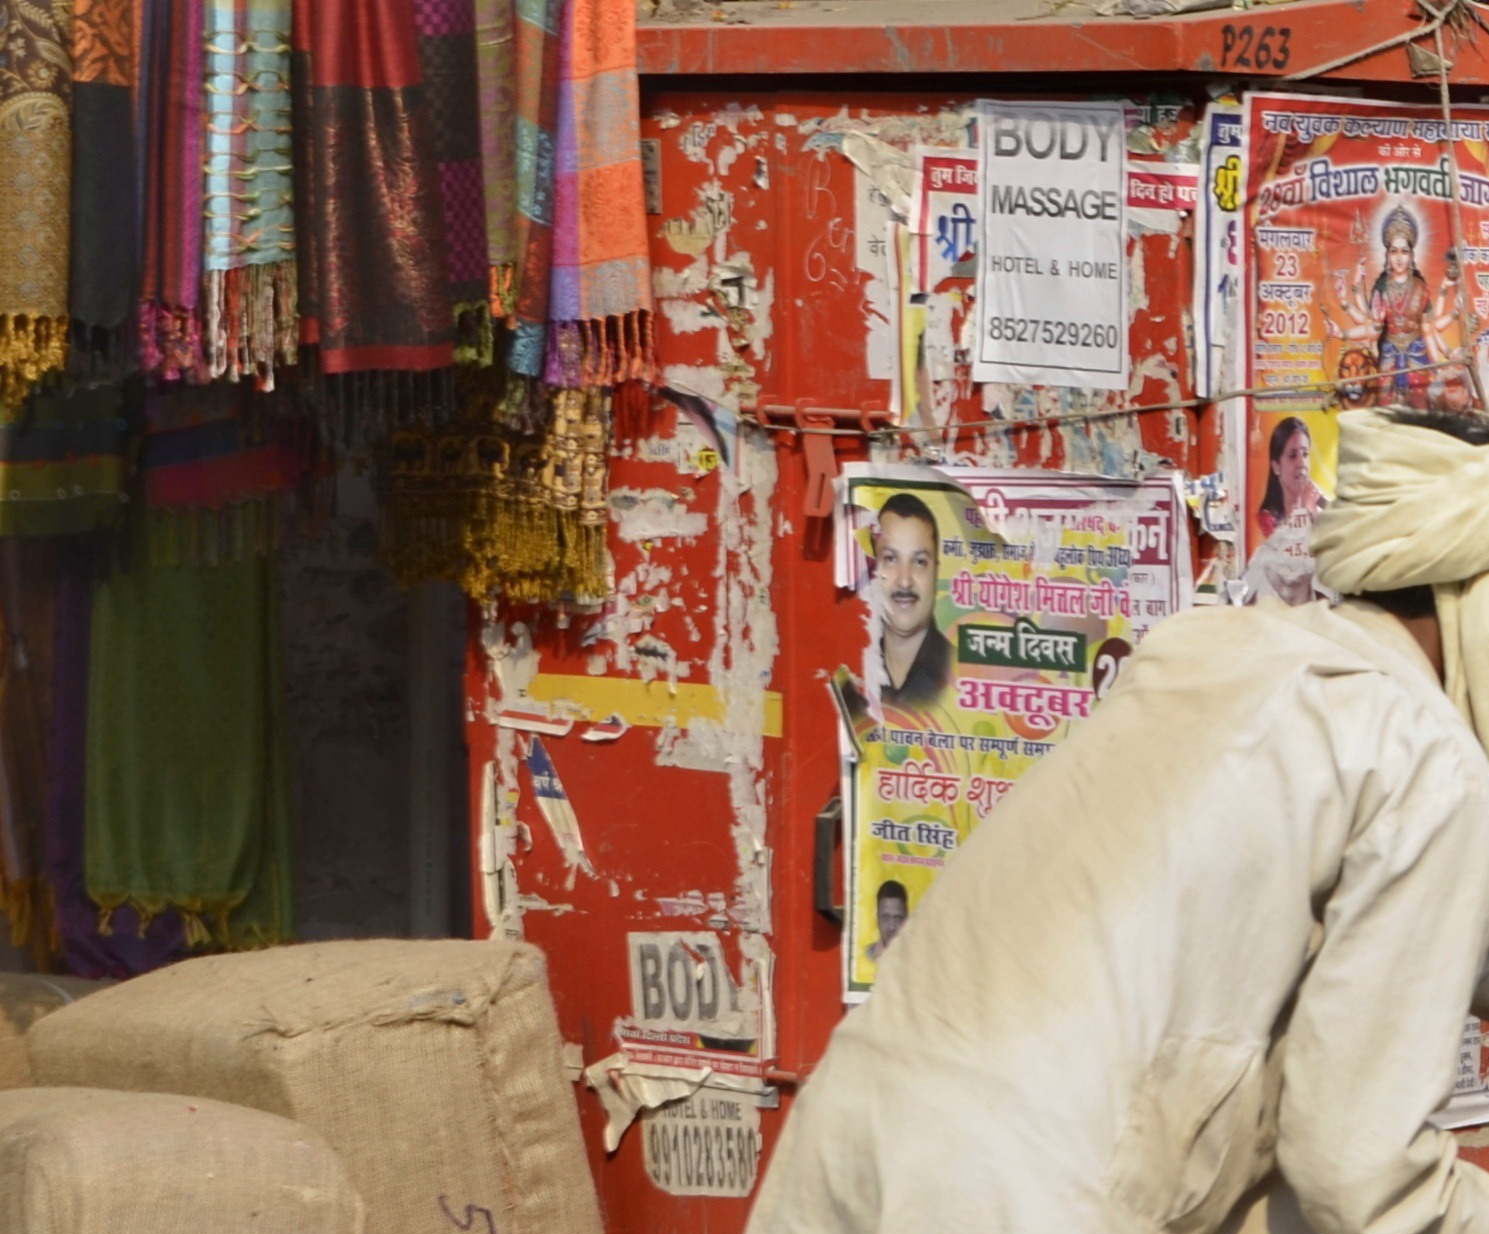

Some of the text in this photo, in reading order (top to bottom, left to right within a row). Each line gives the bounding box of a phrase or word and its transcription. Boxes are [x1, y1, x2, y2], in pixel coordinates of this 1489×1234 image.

[1221, 24, 1291, 69] P263
[993, 112, 1115, 163] BODY
[1262, 112, 1292, 133] नव
[1295, 114, 1341, 144] युवक
[1344, 116, 1408, 138] कल्याण
[930, 166, 954, 188] तुम
[1130, 178, 1156, 200] दिन
[1158, 181, 1175, 204] हो
[1310, 158, 1379, 200] विशाल
[991, 184, 1119, 221] MASSAGE
[935, 203, 977, 263] श्री
[1258, 221, 1315, 250] मंगलवार
[991, 256, 1119, 280] HOTEL & HOME
[1276, 254, 1298, 277] 23
[1260, 284, 1313, 308] अक्टूबर
[989, 316, 1119, 349] 8527529260
[1264, 313, 1310, 335] 2012
[953, 569, 974, 608] श्री
[979, 574, 1030, 612] योगेश
[1091, 578, 1114, 616] जी
[967, 621, 1077, 665] जन्म दिवस
[1098, 653, 1122, 701] 2
[959, 679, 1094, 727] अक्टूबर
[959, 735, 975, 751] पर
[878, 761, 961, 804] हार्दिक
[871, 820, 955, 849] जीत सिंह
[711, 1102, 743, 1122] HOME
